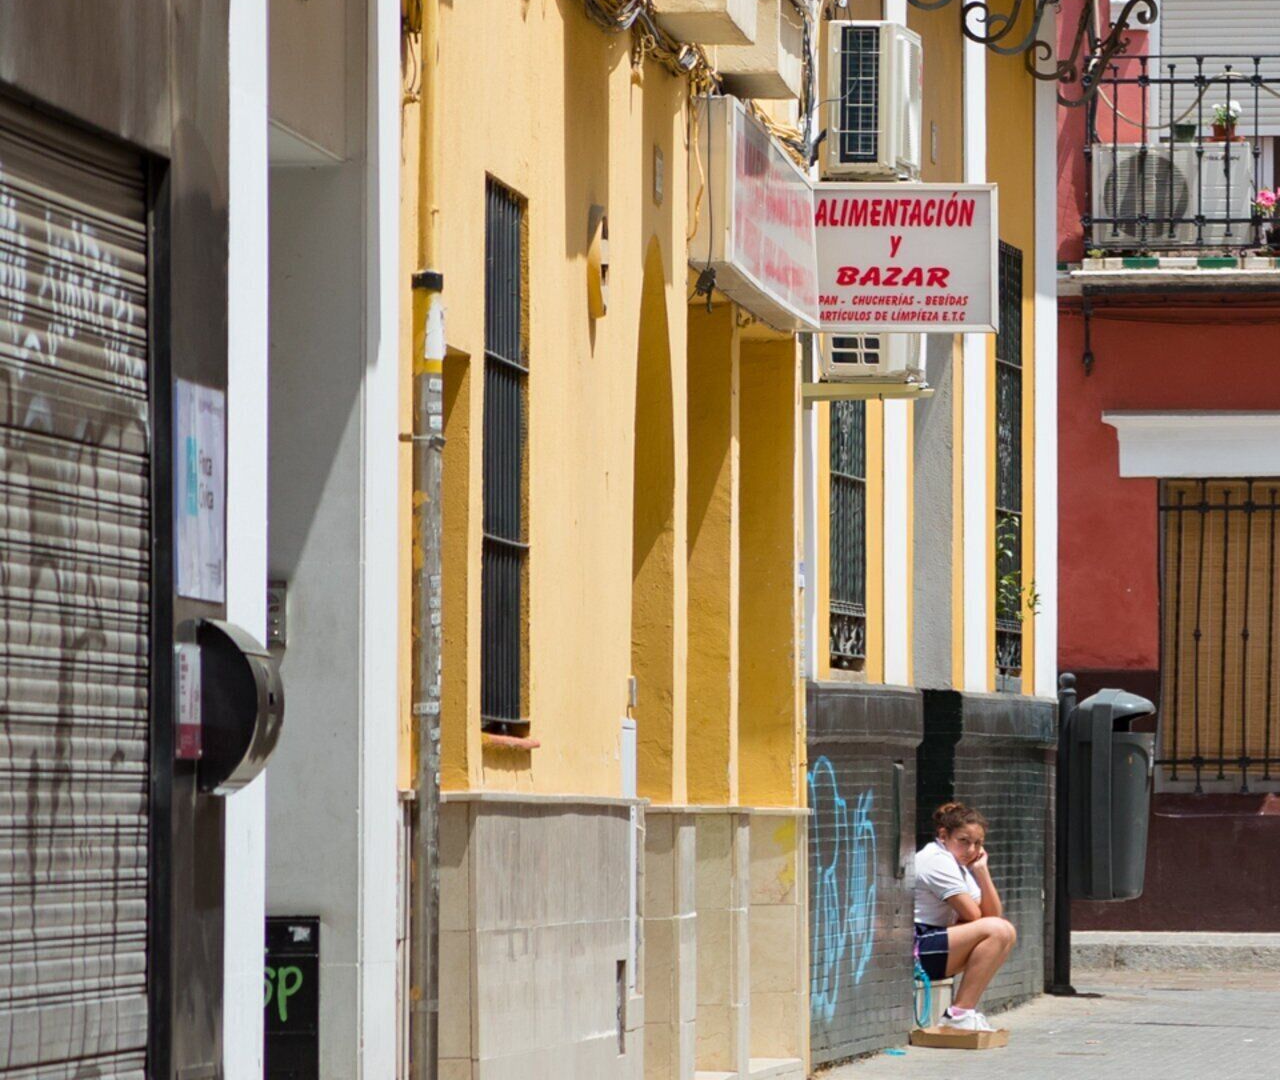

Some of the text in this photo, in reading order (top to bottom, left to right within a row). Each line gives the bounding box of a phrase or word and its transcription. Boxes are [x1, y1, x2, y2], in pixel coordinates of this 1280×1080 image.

[815, 192, 975, 227] ALIMENTACIÓN
[836, 266, 950, 288] BAZAR
[818, 295, 838, 305] PAN
[874, 311, 887, 321] DE
